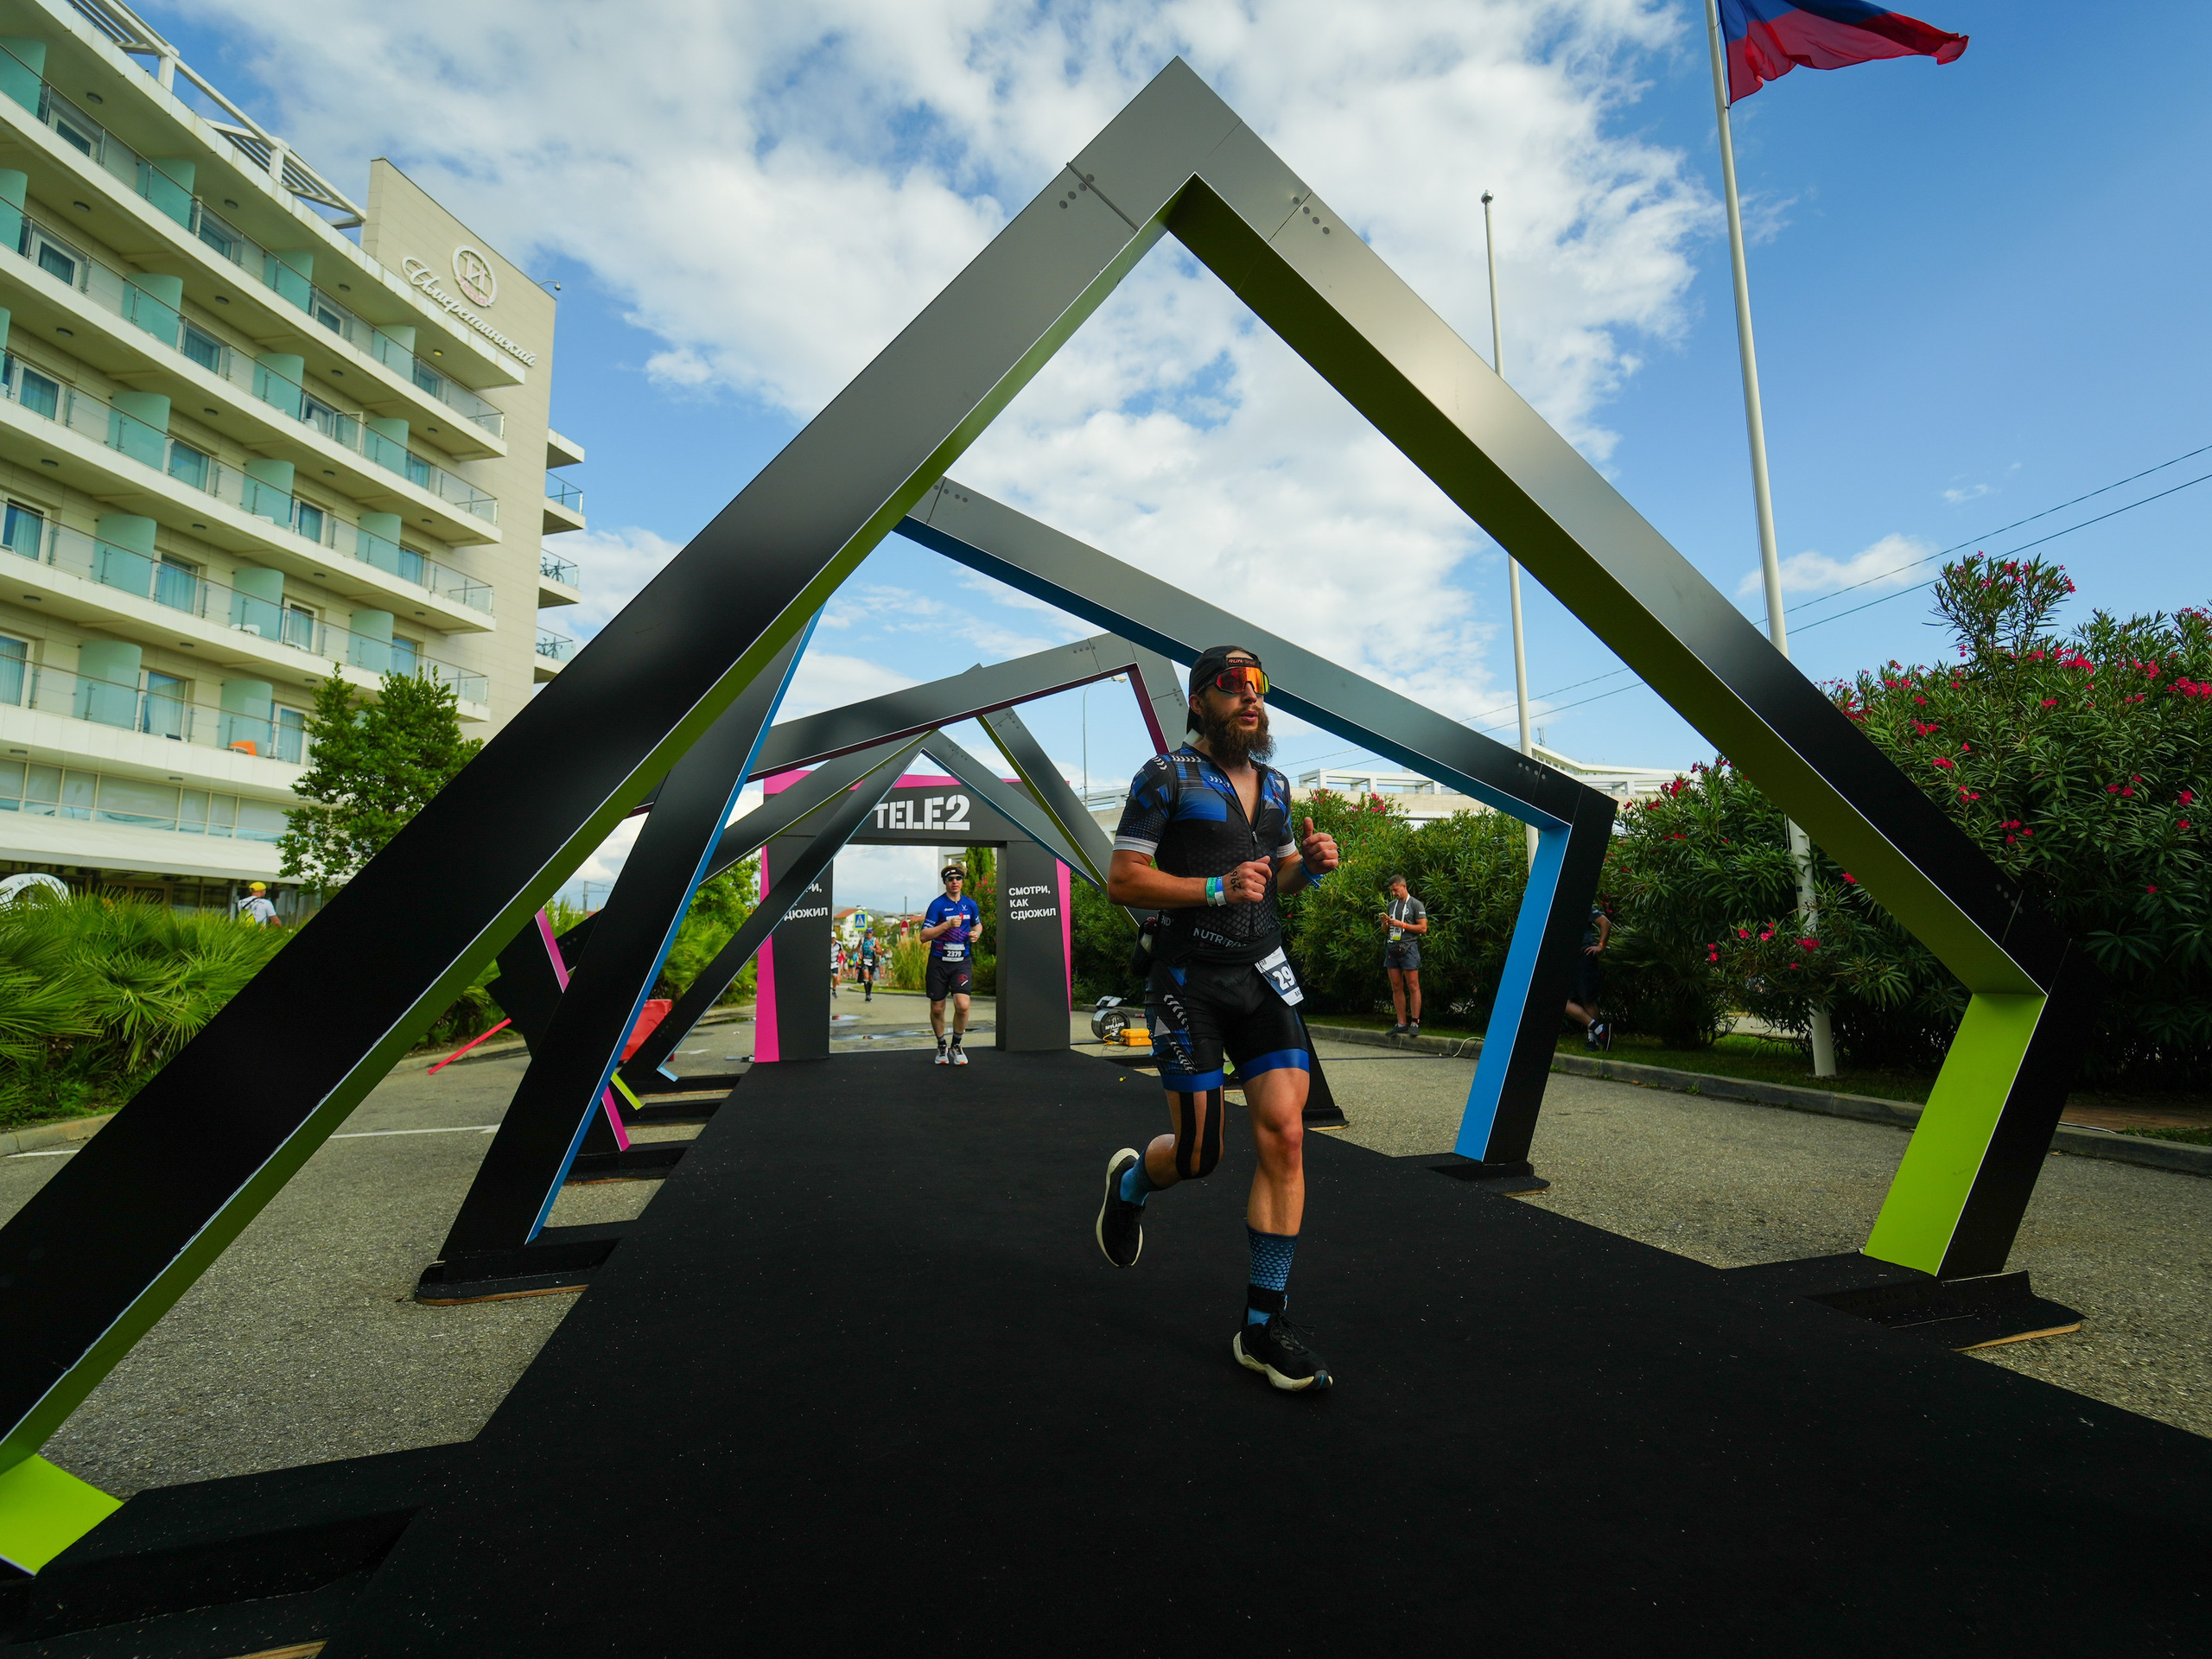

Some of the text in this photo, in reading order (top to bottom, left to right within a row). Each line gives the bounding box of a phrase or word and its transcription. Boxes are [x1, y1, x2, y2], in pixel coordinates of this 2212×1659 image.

[874, 794, 970, 830] TELE2
[1008, 885, 1051, 896] СМОТРИ,
[1009, 899, 1029, 907] КАК
[784, 907, 829, 921] ДЮЖИЛ
[1010, 907, 1056, 920] СДЮЖИЛ
